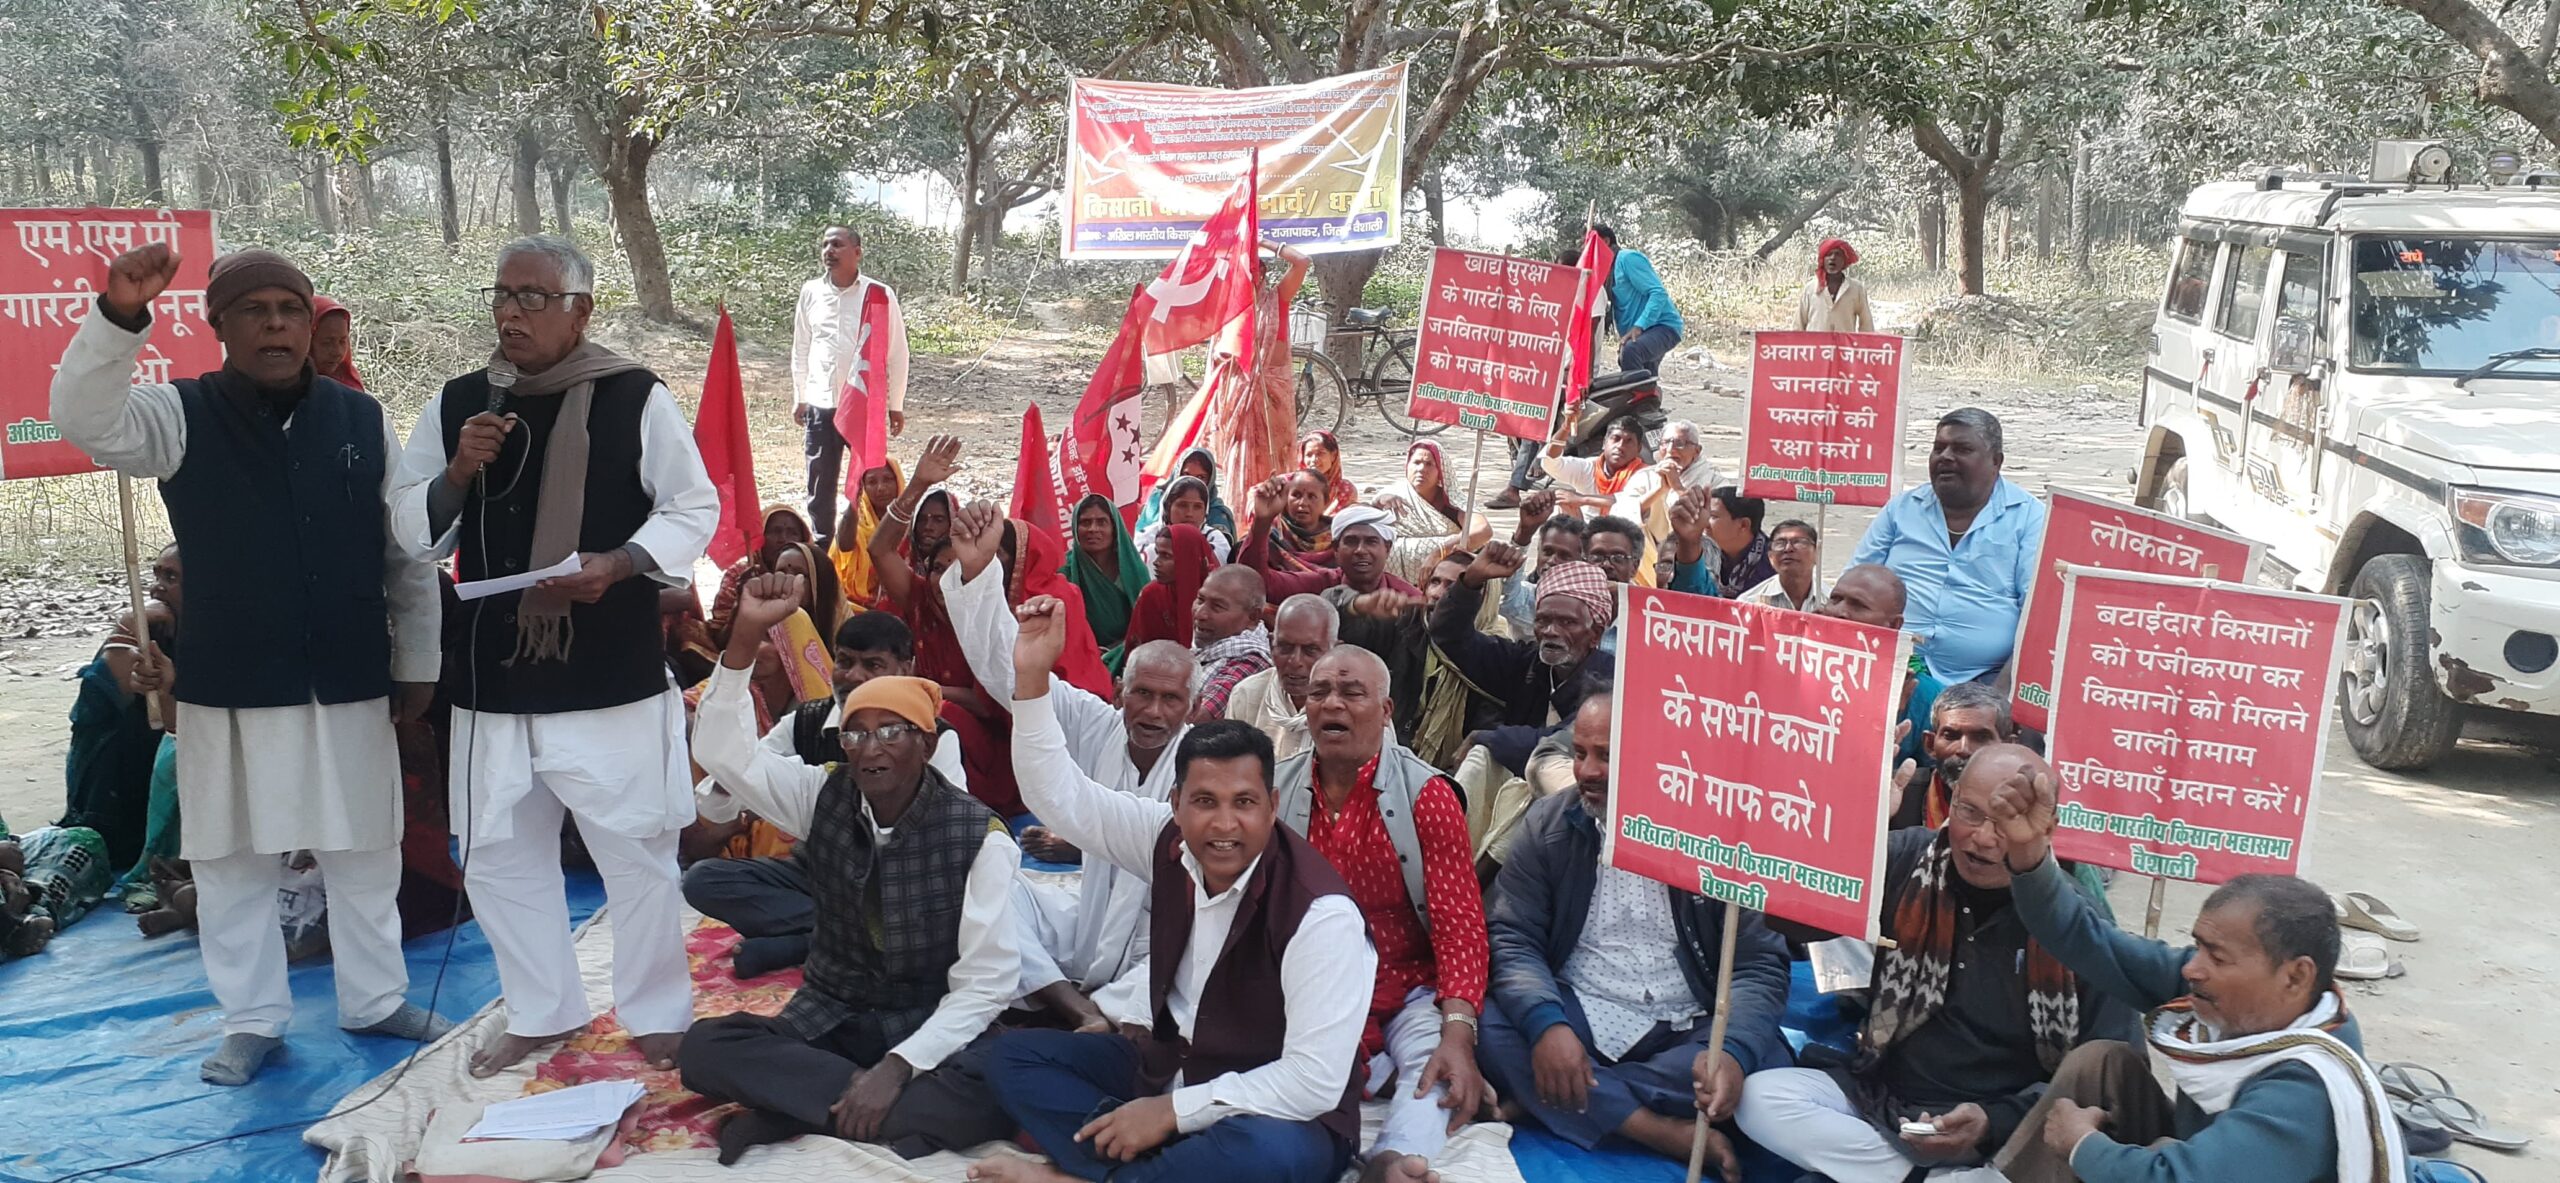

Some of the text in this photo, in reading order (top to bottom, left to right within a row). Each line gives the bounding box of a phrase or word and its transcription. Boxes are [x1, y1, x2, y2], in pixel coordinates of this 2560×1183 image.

[1353, 216, 1384, 234] वैशाली
[1464, 254, 1552, 286] खाद्य सुरक्षा
[1, 277, 207, 337] गारंटी ानून
[1441, 278, 1562, 327] के गारंटी के लिए
[1428, 315, 1563, 355] जनवितरण प्रणाली
[1760, 342, 1896, 366] अवारा व जंगली
[1429, 346, 1453, 371] को
[1456, 355, 1506, 385] मजबुत
[1770, 371, 1881, 398] जानवरों से
[1417, 383, 1549, 420] अखिल भारतीय किसान महासभा
[1460, 409, 1496, 431] वैशाली
[1768, 403, 1879, 429] फसलों की
[7, 417, 62, 444] अखिल
[1770, 438, 1814, 460] रक्षा
[1750, 463, 1888, 488] अखिल भारतीय किसान महासभा
[1796, 485, 1835, 505] वैशाली
[2090, 515, 2204, 572] लोकतंत्र
[2096, 602, 2314, 649] बटाईदार किसानों
[1773, 631, 1880, 703] मजंदूरों
[2090, 637, 2130, 669] को
[2135, 643, 2257, 685] पंजीकरण
[2262, 664, 2304, 690] कर
[2018, 682, 2051, 710] अखि
[2081, 676, 2309, 733] किसानों को मिलने
[1661, 674, 1843, 763] के सभी कर्जों
[2112, 727, 2258, 768] वाली तमाम
[1656, 750, 1699, 807] को
[1703, 773, 1763, 823] माफ
[2058, 757, 2167, 803] सुविधाएँ
[2169, 775, 2236, 805] प्रदान
[2109, 811, 2167, 842] भारतीय
[2168, 820, 2225, 851] किसान
[2226, 831, 2292, 860] महासभा
[1622, 816, 1863, 902] अखिल भारतीय किसान महासभा
[2131, 844, 2198, 879] वैशाली
[1699, 865, 1767, 912] वैशाली
